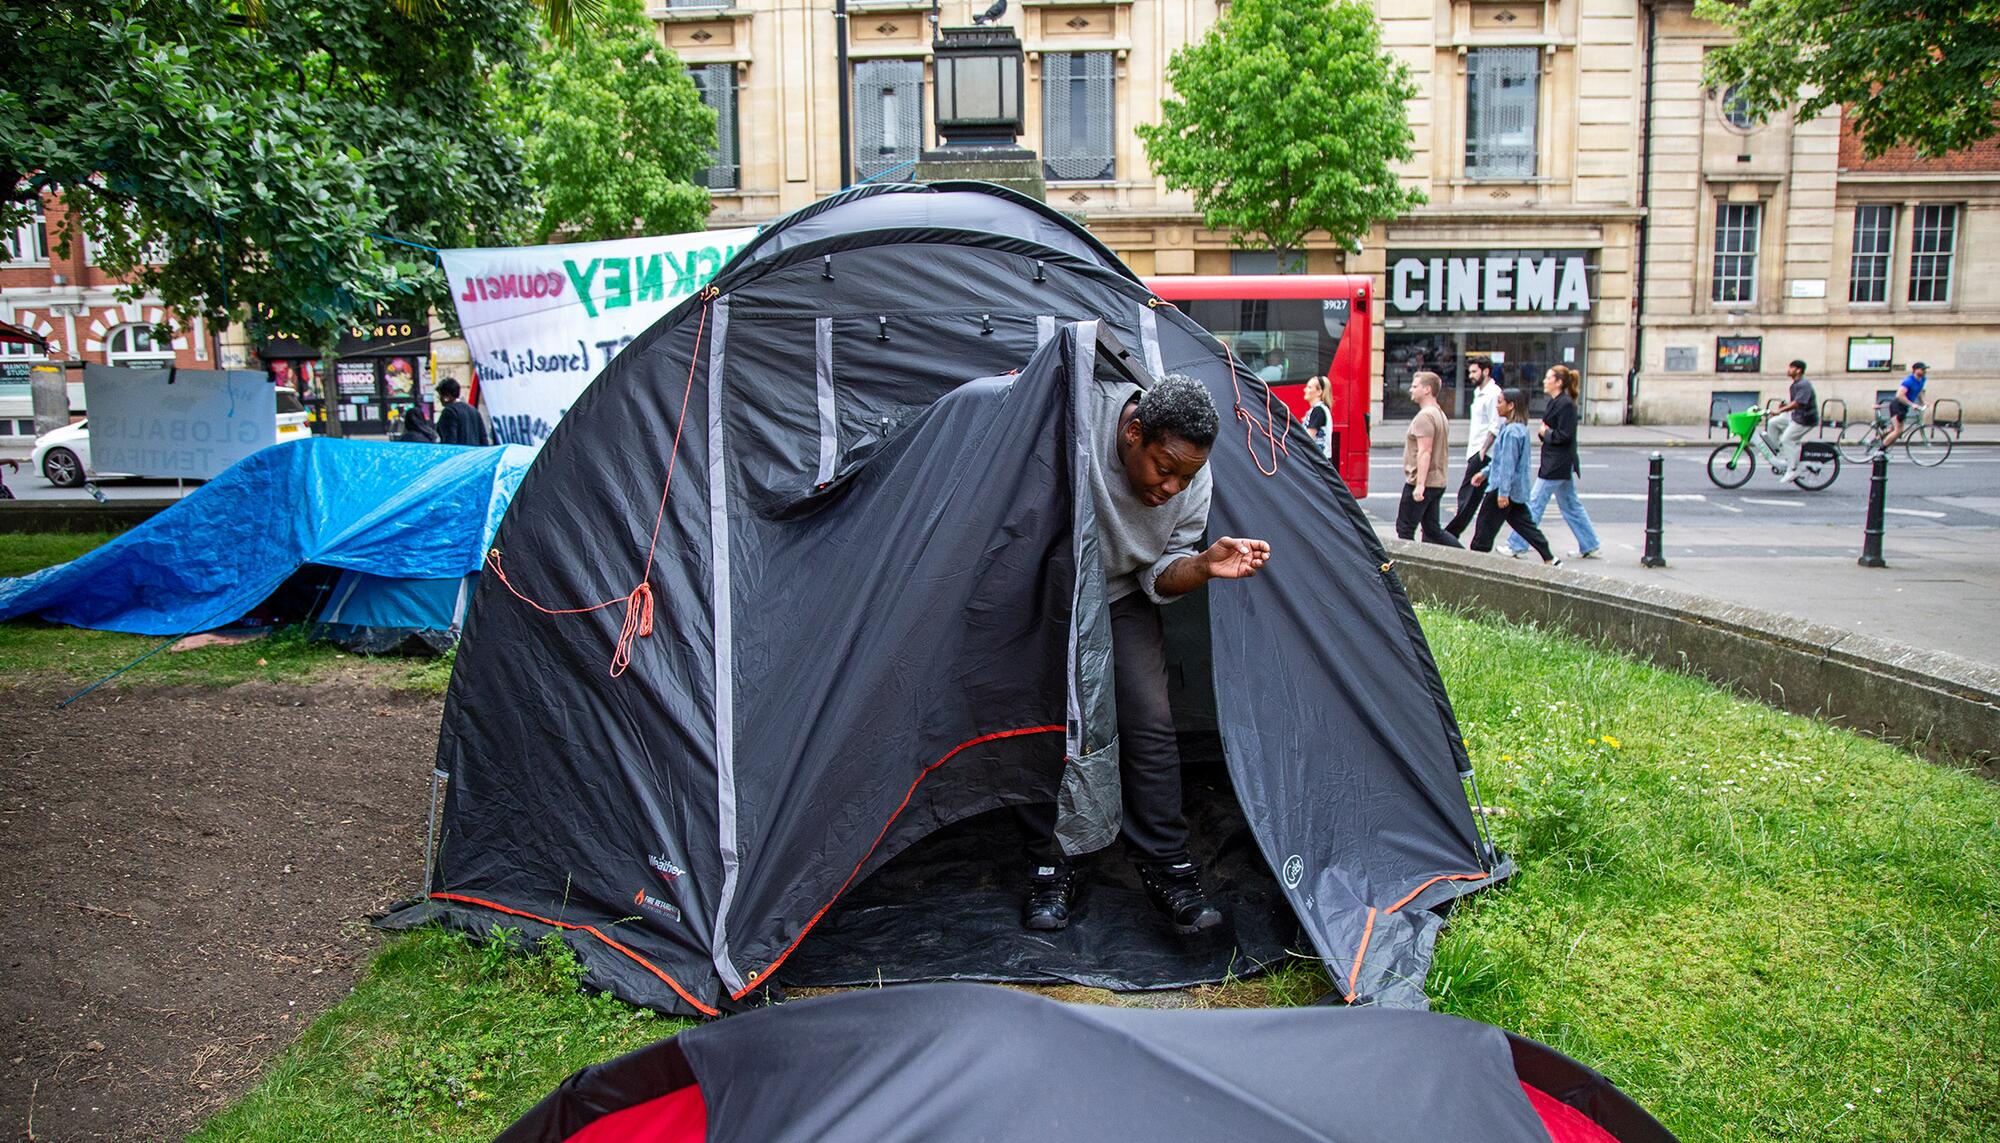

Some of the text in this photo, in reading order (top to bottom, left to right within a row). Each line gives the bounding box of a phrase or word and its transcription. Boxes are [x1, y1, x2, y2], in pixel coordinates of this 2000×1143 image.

[1393, 256, 1590, 312] CINEMA
[1323, 300, 1347, 310] 39127
[352, 324, 412, 338] BNGO
